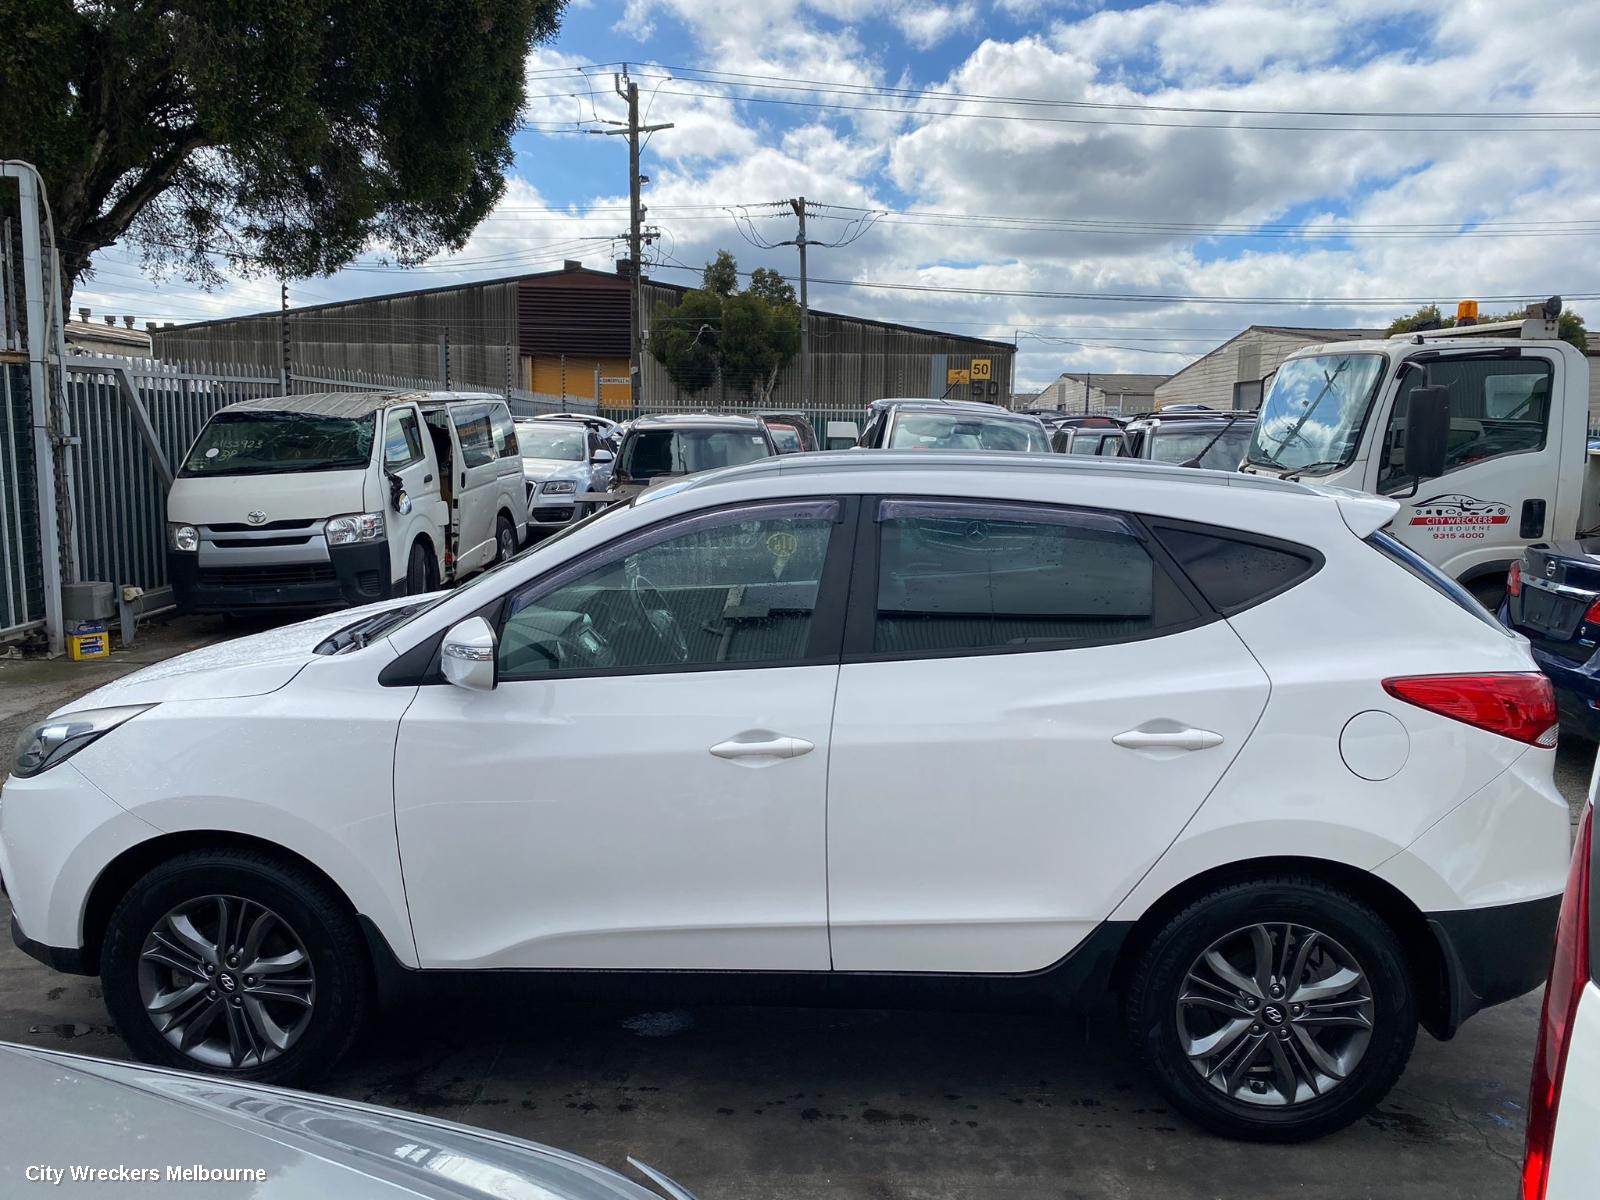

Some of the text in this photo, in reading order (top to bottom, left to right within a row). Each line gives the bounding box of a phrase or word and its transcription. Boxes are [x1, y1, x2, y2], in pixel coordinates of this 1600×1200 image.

[973, 363, 989, 375] 50
[972, 380, 999, 396] 50
[1426, 516, 1493, 525] CITY WRECKERS
[1432, 532, 1456, 540] 9315
